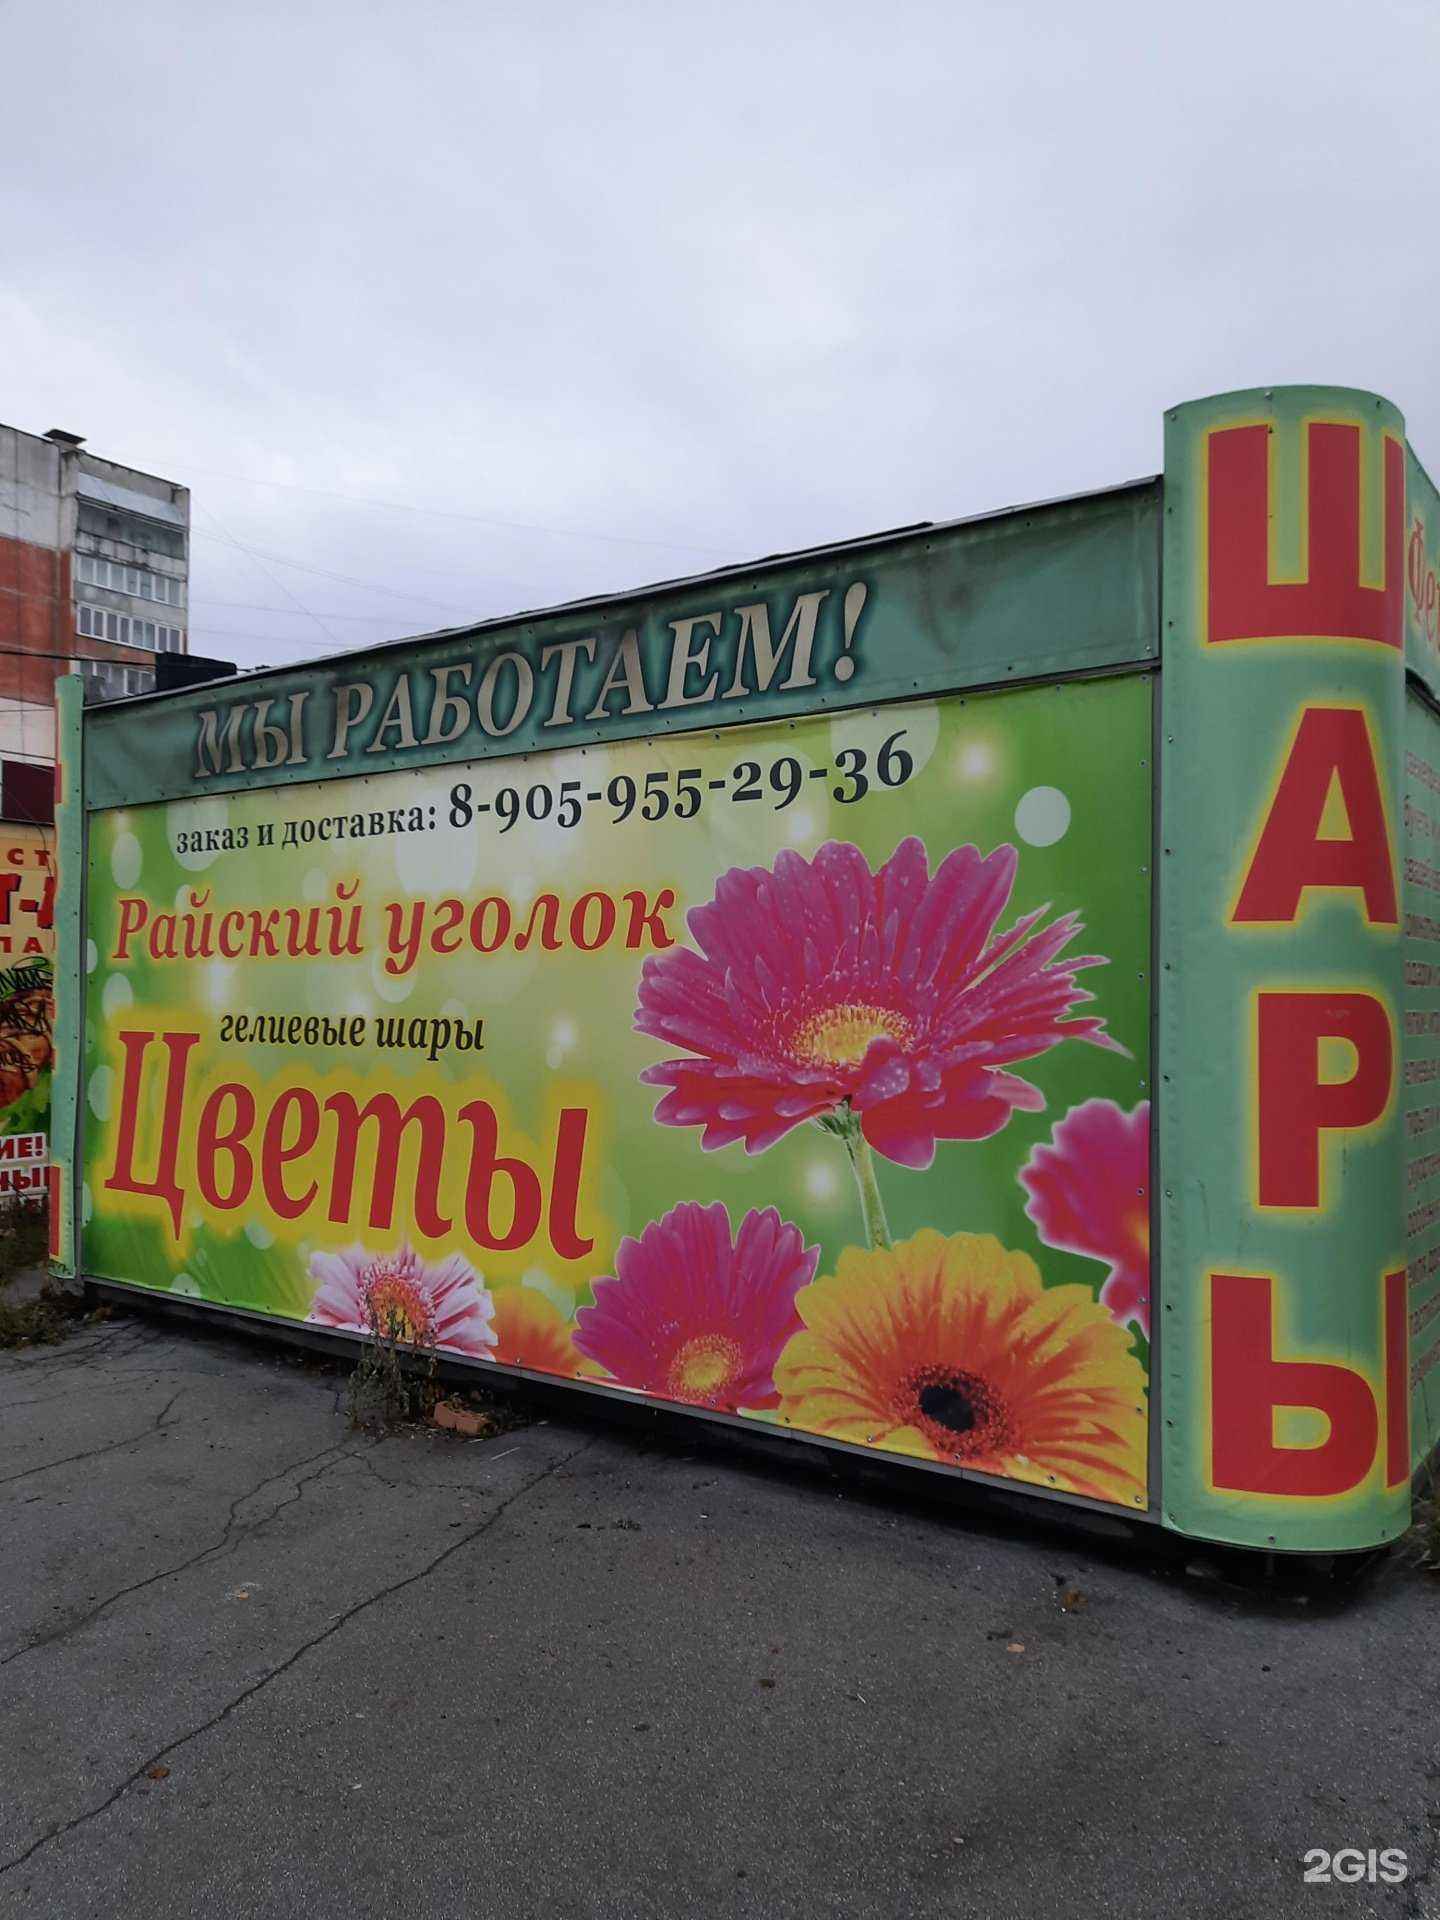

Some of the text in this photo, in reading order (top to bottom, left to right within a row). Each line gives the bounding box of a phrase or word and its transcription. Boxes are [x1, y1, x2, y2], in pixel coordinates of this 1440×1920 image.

[193, 581, 868, 779] МЫ РАБОТАЕМ!
[176, 730, 914, 855] заказ и доставка: 8-905-955-29-36
[112, 879, 676, 975] Райский уголок
[1207, 422, 1410, 1497] ШАРЫ
[219, 1011, 486, 1061] гелиевые шары
[104, 1030, 595, 1261] Цветы
